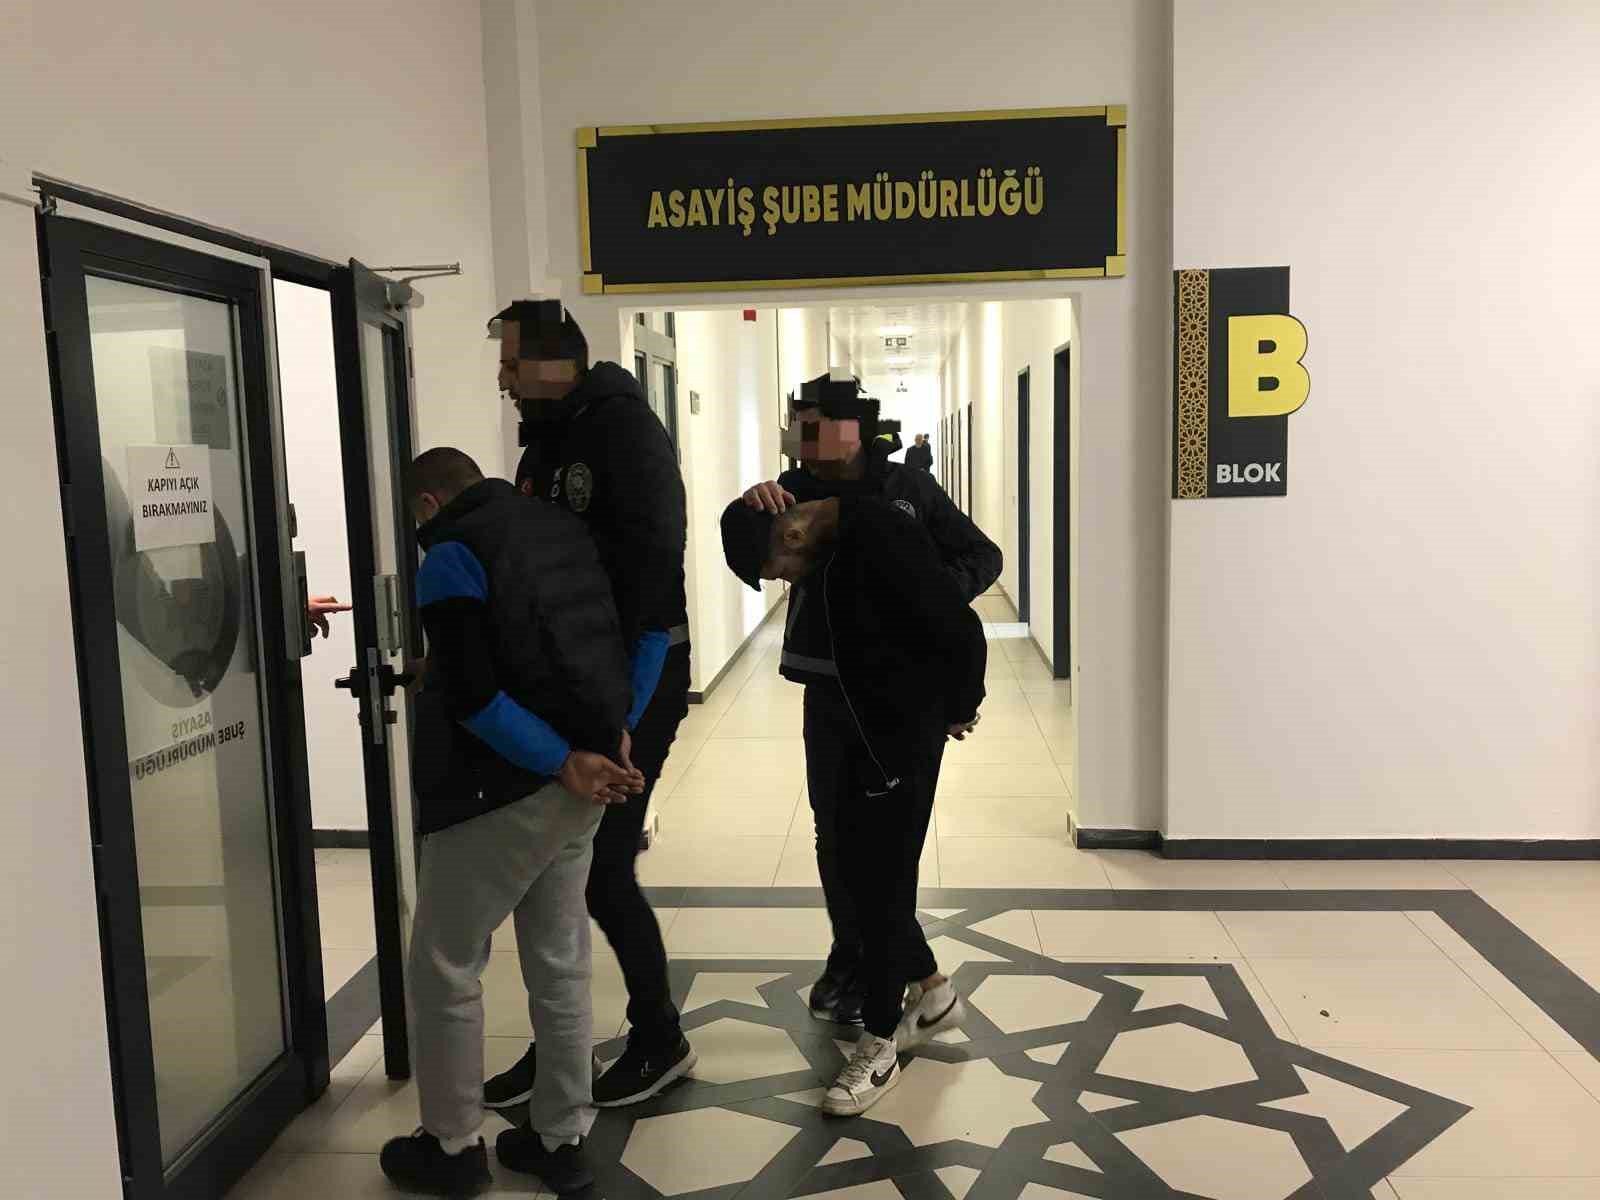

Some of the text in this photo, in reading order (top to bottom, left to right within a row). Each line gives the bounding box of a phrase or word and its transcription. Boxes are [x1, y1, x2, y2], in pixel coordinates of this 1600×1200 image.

[647, 166, 1044, 236] ASAYİŞ ŞUBE MÜDÜRLÜĞÜ
[1227, 313, 1310, 417] B
[1216, 462, 1281, 484] BLOK
[147, 476, 200, 493] KAPIYI AÇIK
[142, 500, 208, 518] BIRAKMAYINIZ
